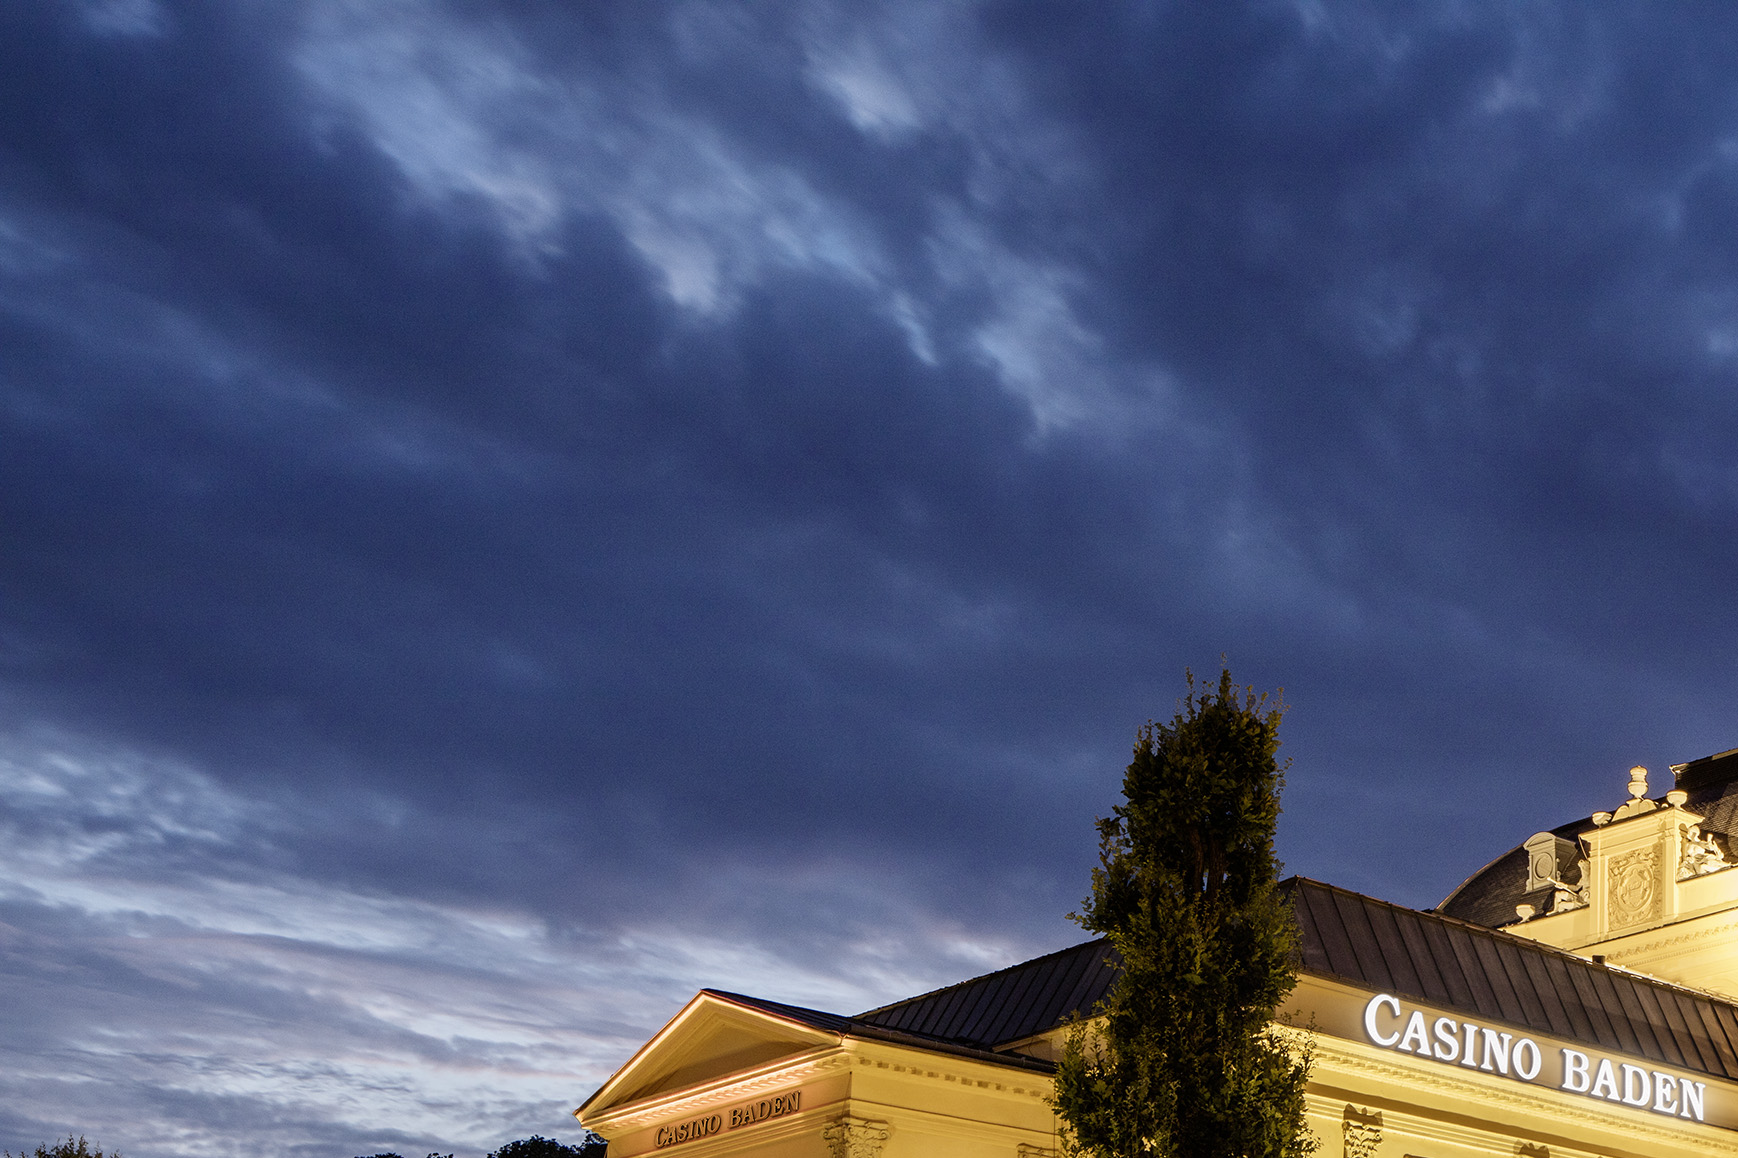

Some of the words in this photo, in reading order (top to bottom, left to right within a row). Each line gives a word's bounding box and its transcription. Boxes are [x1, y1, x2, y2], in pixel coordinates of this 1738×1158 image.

[1364, 993, 1542, 1081] CASINO
[1561, 1047, 1706, 1122] BADEN
[654, 1114, 722, 1148] CASINO
[727, 1090, 801, 1129] BADEN
